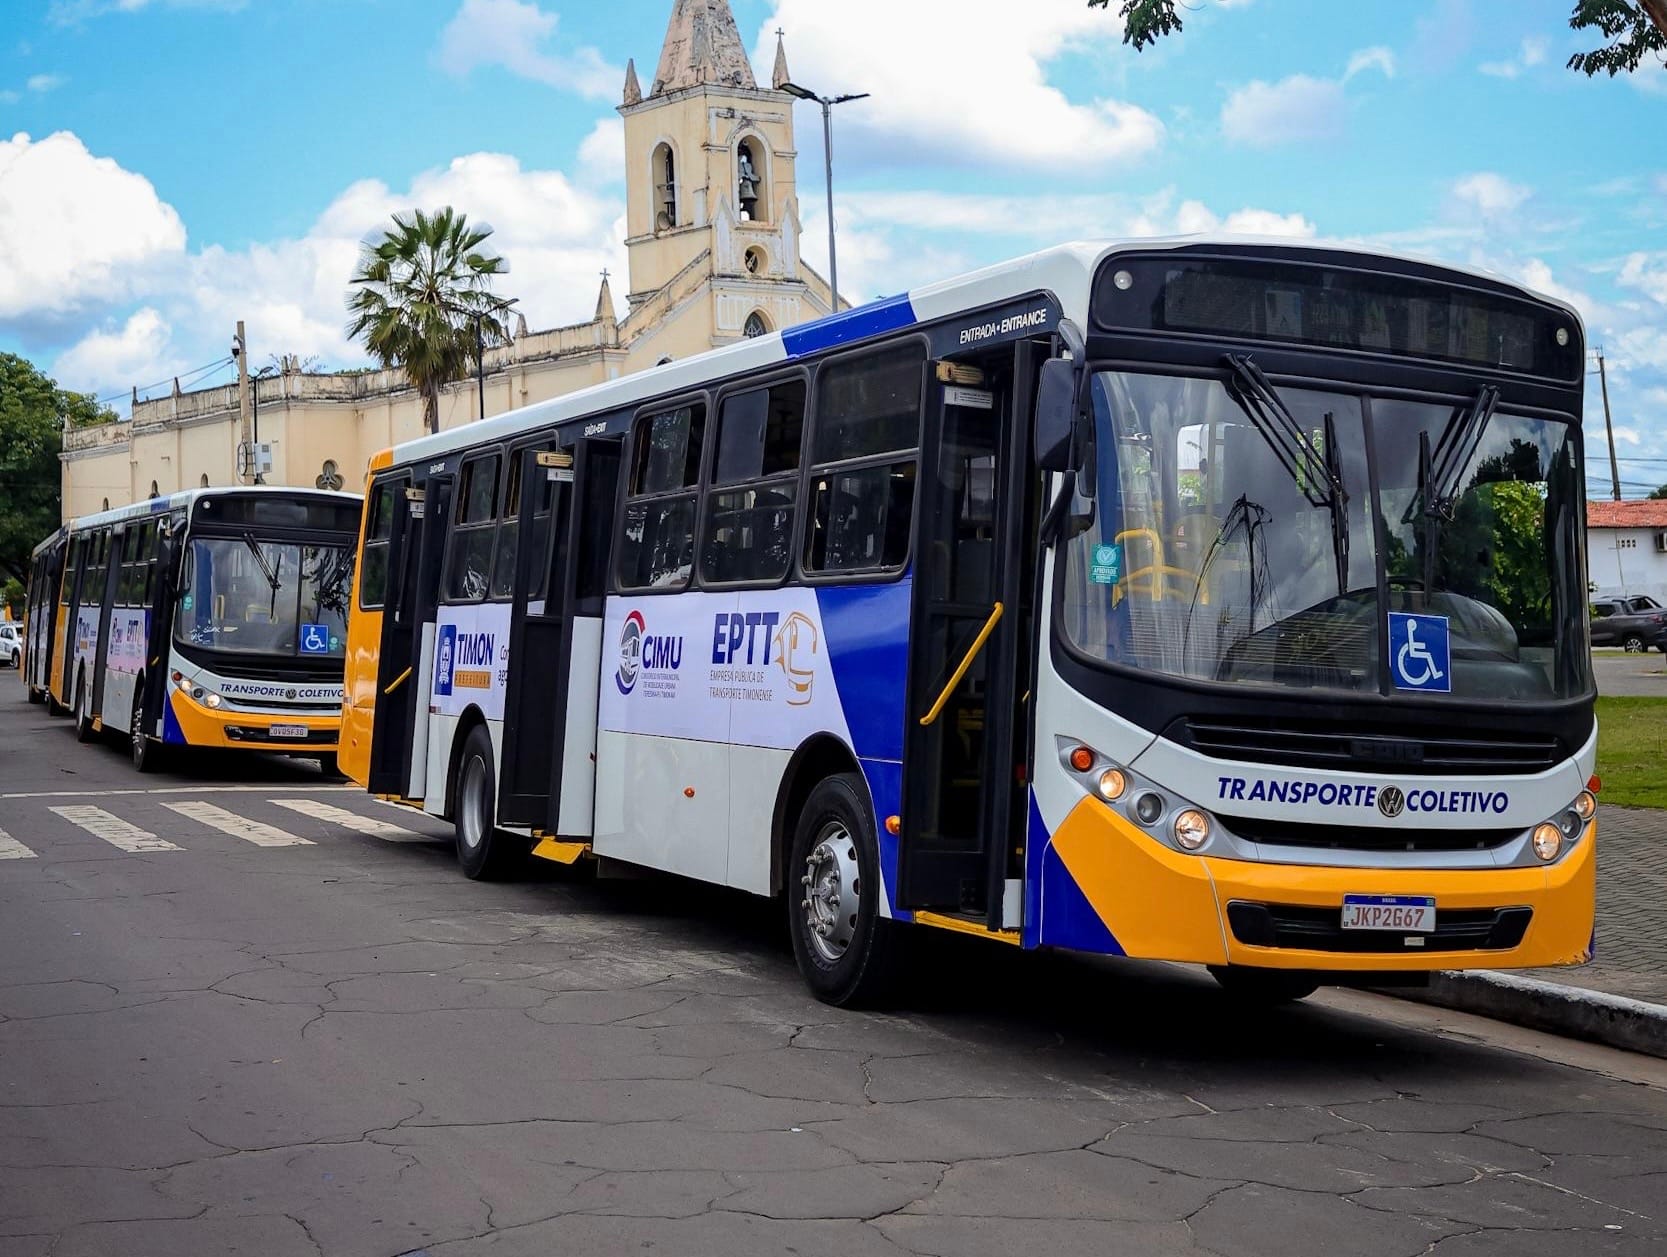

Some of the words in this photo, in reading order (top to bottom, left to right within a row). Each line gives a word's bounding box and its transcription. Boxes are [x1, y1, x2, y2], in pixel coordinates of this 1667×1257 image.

[960, 324, 996, 344] ENTRADA
[1001, 308, 1047, 333] ENTRANCE
[458, 633, 495, 666] TIMON
[642, 635, 683, 669] CIMU
[712, 612, 779, 665] EPTT
[220, 683, 286, 697] TRANSPORTE
[1218, 777, 1378, 808] TRANSPORTE
[1406, 789, 1509, 814] COLETIVO
[1351, 907, 1425, 928] JKP2G67
